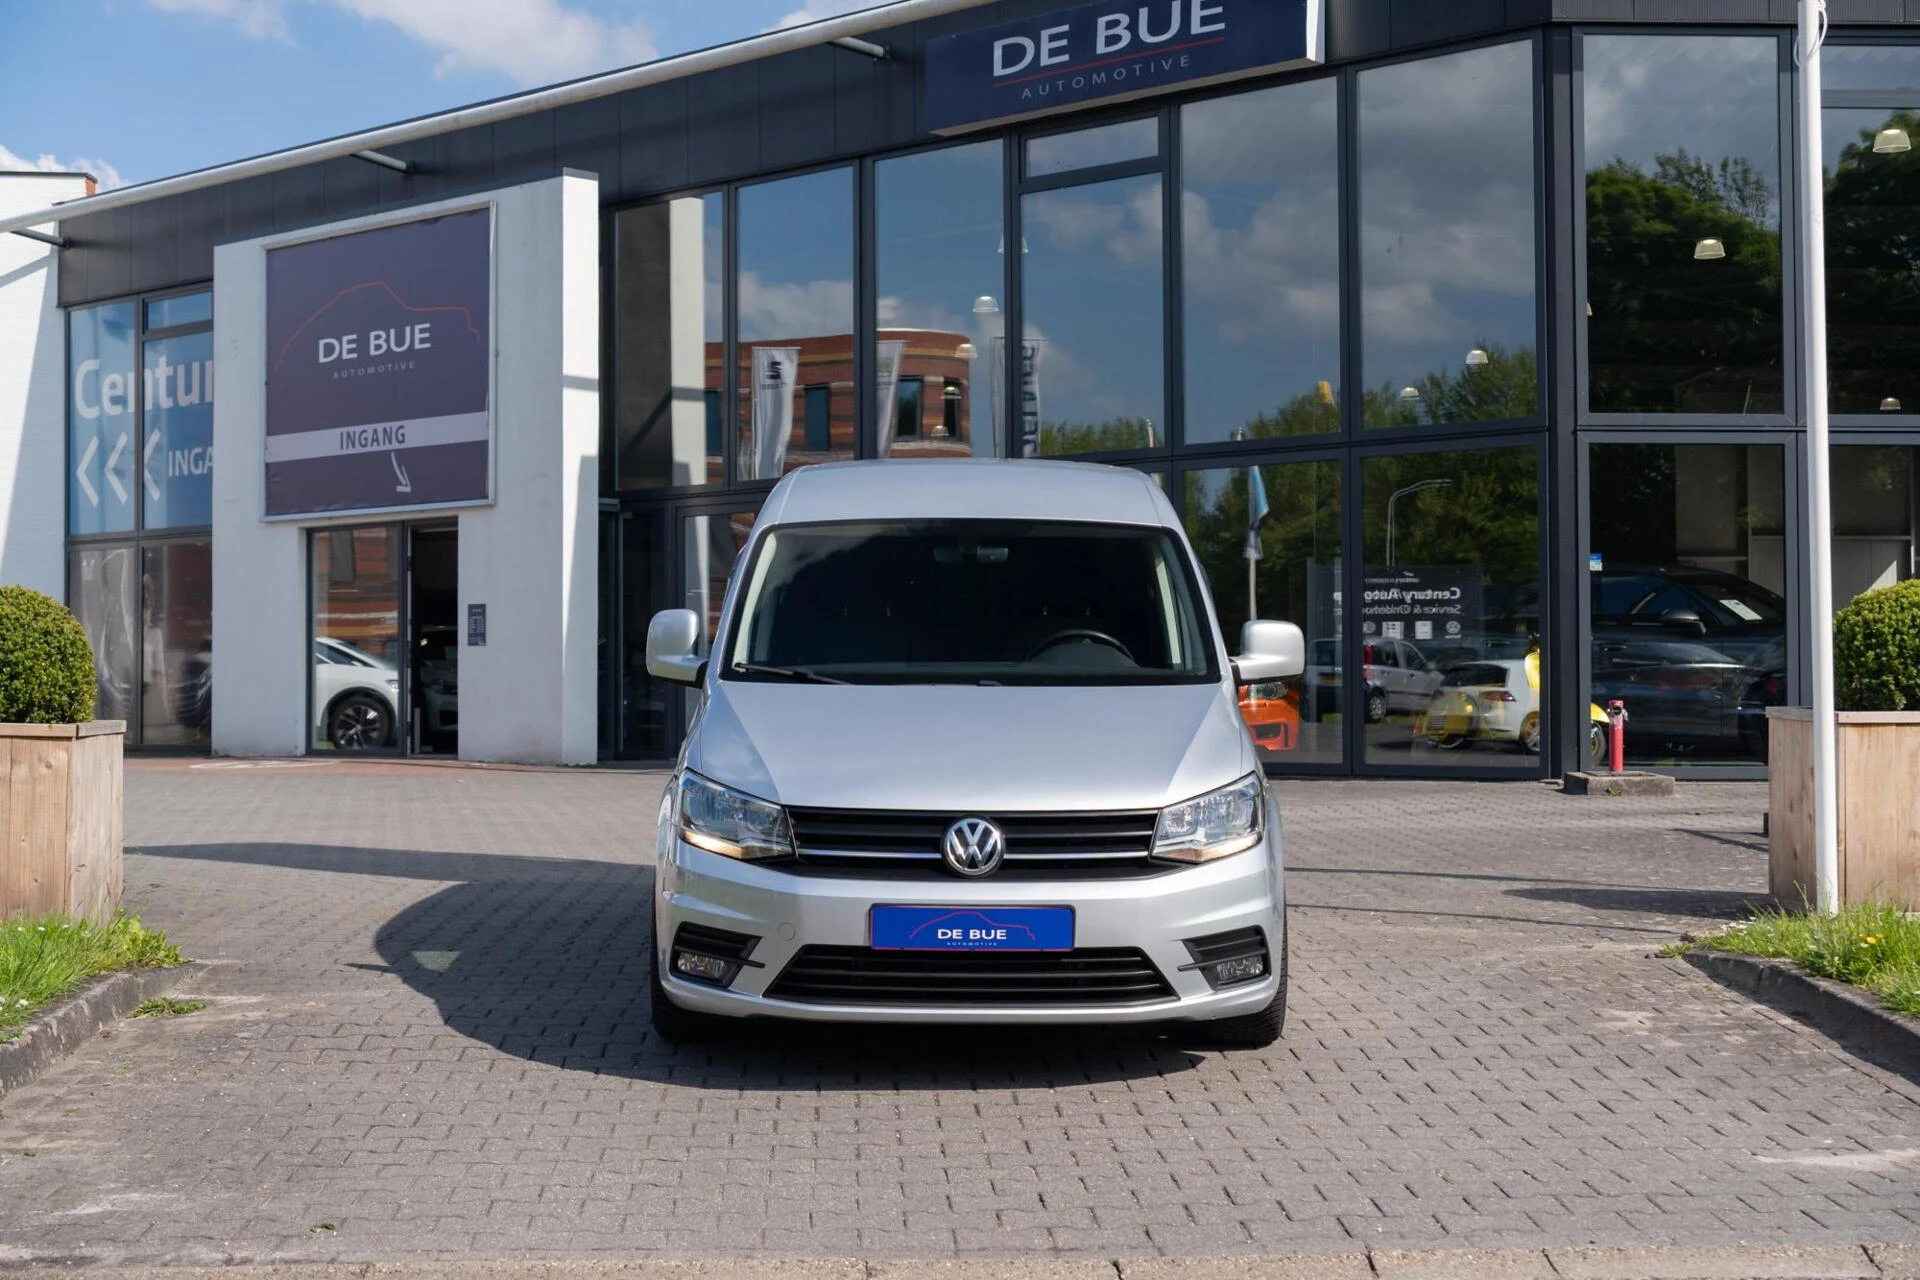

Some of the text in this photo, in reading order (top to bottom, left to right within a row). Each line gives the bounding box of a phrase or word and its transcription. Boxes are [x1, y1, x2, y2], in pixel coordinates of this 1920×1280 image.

[992, 0, 1226, 77] DE BUE
[1021, 54, 1192, 100] AUTOMOTIVE
[317, 322, 432, 364] DE BUE
[333, 361, 416, 379] AUTOMOTIVE
[339, 424, 406, 451] INGANG
[937, 929, 1007, 940] DE BUE
